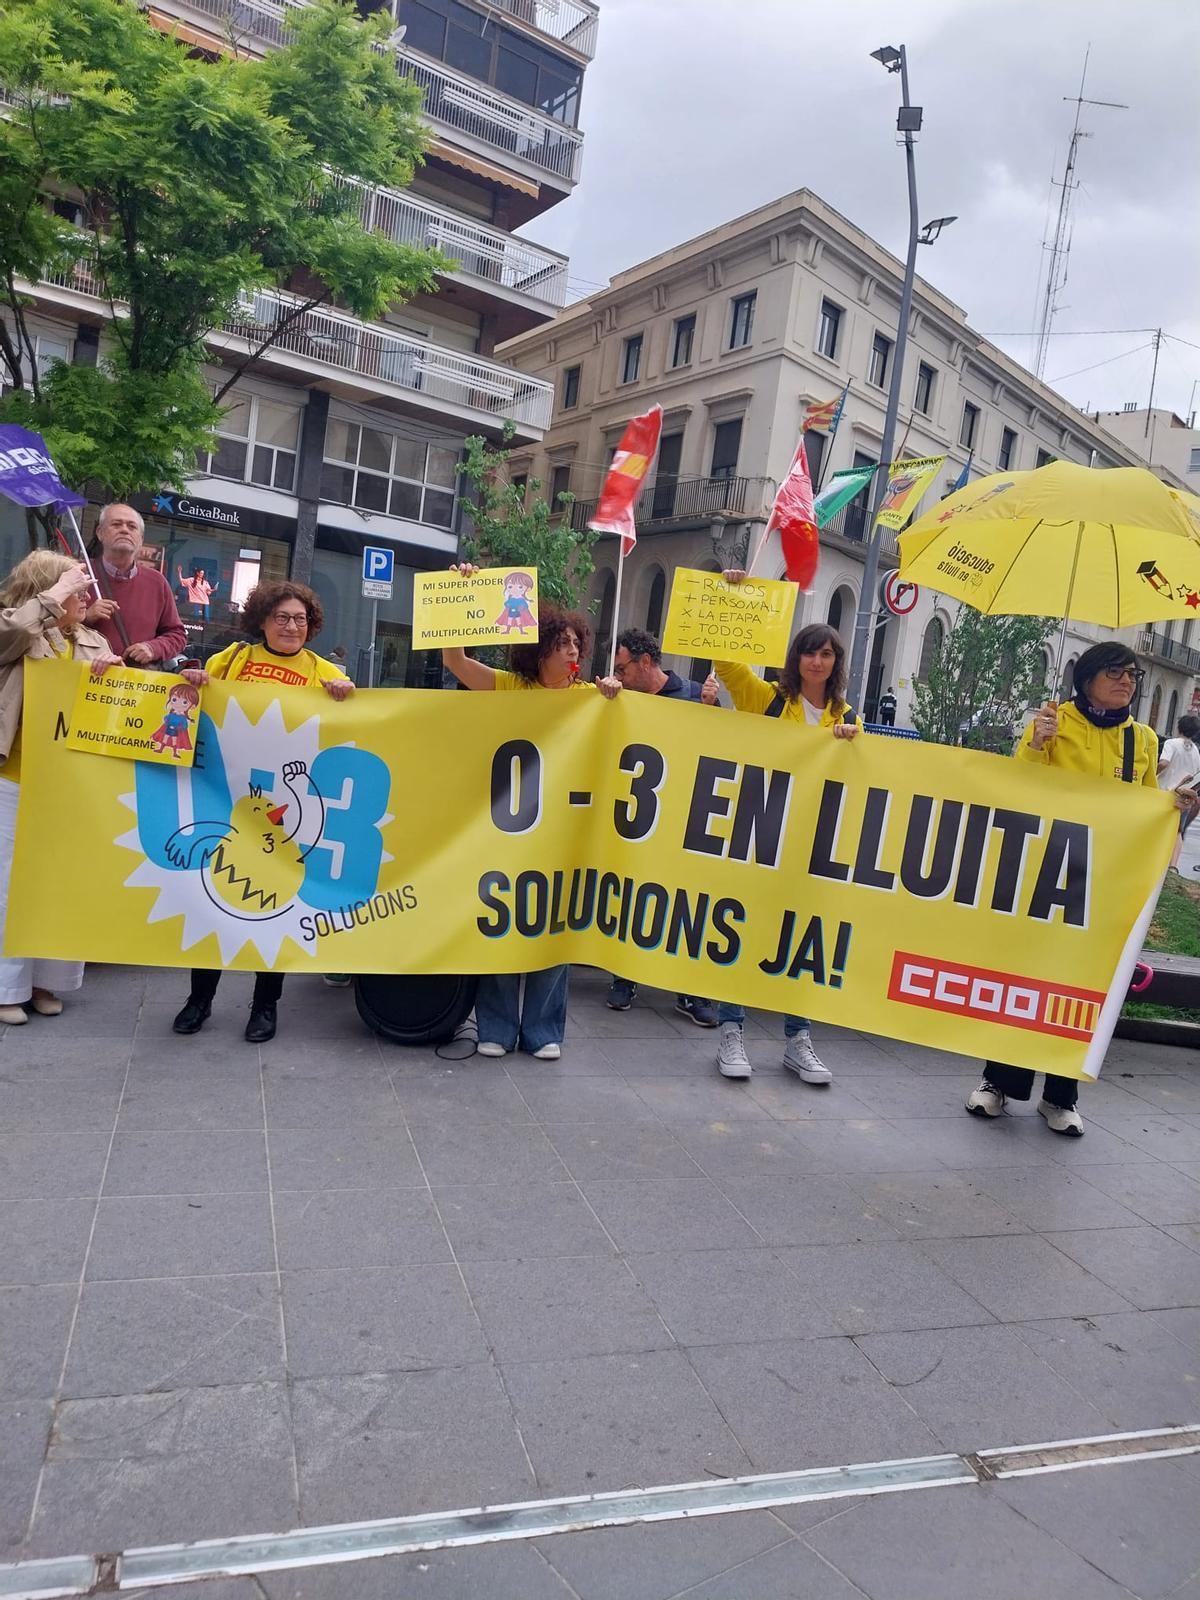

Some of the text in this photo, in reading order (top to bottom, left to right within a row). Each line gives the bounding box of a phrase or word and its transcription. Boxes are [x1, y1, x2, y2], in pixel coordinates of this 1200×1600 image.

[178, 500, 240, 524] CaixaBank
[370, 551, 388, 577] P
[423, 577, 503, 591] MI SUPER PODER
[422, 594, 475, 605] ES EDUCAR
[701, 593, 780, 613] PERSONAL
[466, 609, 486, 619] NO
[698, 609, 715, 621] LA
[719, 612, 762, 625] ETAPA
[421, 625, 500, 638] MULTIPLICARME
[699, 622, 753, 640] TODOS
[691, 637, 766, 654] CALIDAD
[88, 675, 167, 694] MI SUPER PODER
[85, 692, 137, 708] ES EDUCAR
[125, 716, 144, 729] NO
[77, 729, 156, 750] MULTIPLICARME
[683, 755, 795, 870] EN
[808, 779, 1093, 930] LLUITA
[299, 884, 418, 942] SOLUCIONS
[476, 868, 853, 989] SOLUCIONS JA!
[899, 963, 1040, 1020] CCOO
